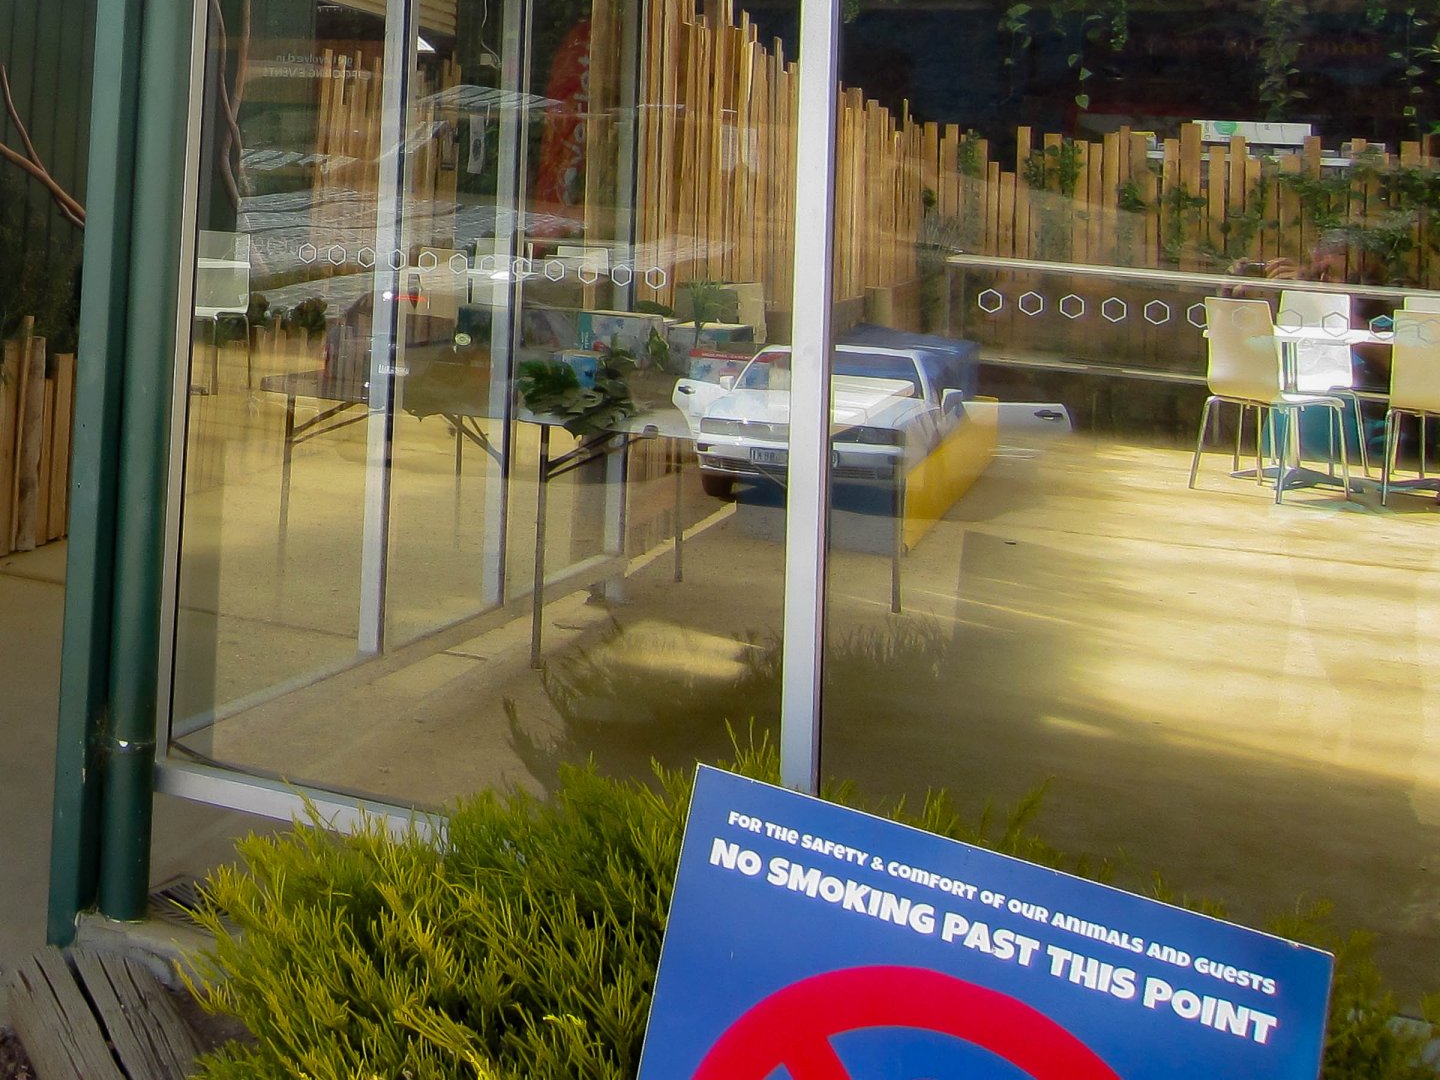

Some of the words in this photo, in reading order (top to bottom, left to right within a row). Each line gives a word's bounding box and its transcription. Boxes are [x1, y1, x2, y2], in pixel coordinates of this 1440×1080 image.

[728, 810, 763, 834] FOR
[871, 856, 884, 872] &
[981, 890, 1006, 909] OF
[709, 838, 762, 876] NO
[767, 858, 935, 934] SMOKING
[941, 912, 1041, 967] PAST
[1047, 945, 1136, 1000] THIS
[1143, 977, 1278, 1045] POINT
